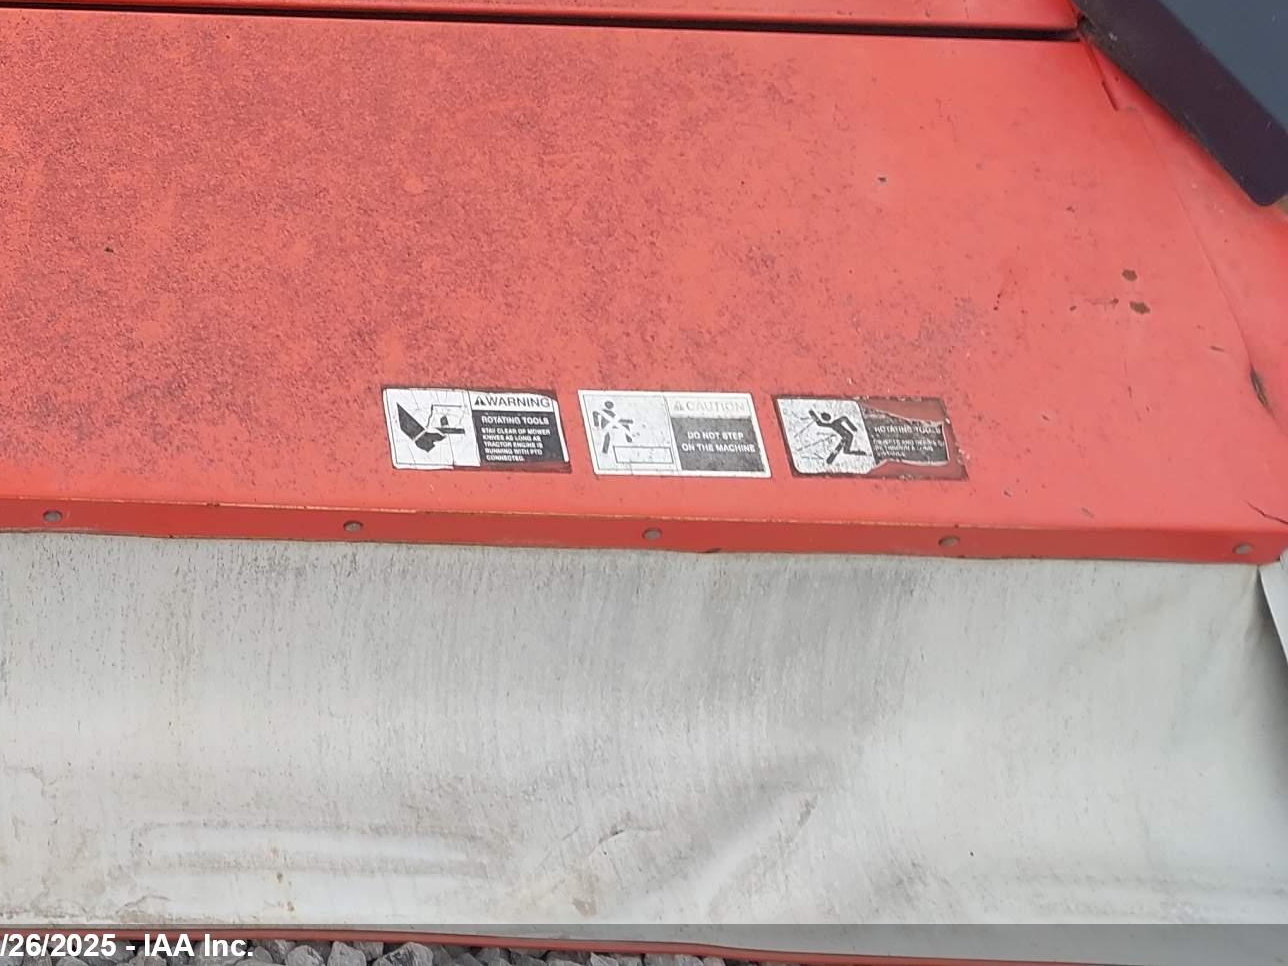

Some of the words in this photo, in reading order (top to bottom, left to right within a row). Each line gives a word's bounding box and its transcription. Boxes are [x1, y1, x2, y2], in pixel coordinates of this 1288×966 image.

[485, 396, 550, 407] WARNING
[686, 401, 744, 411] CAUTION
[481, 415, 521, 425] ROTATING
[522, 416, 550, 425] TOOLS
[687, 431, 700, 440] DO
[702, 432, 720, 440] NOT
[722, 432, 744, 440] STEP
[681, 443, 695, 452] ON
[696, 443, 714, 452] THE
[715, 444, 755, 452] MACHINE
